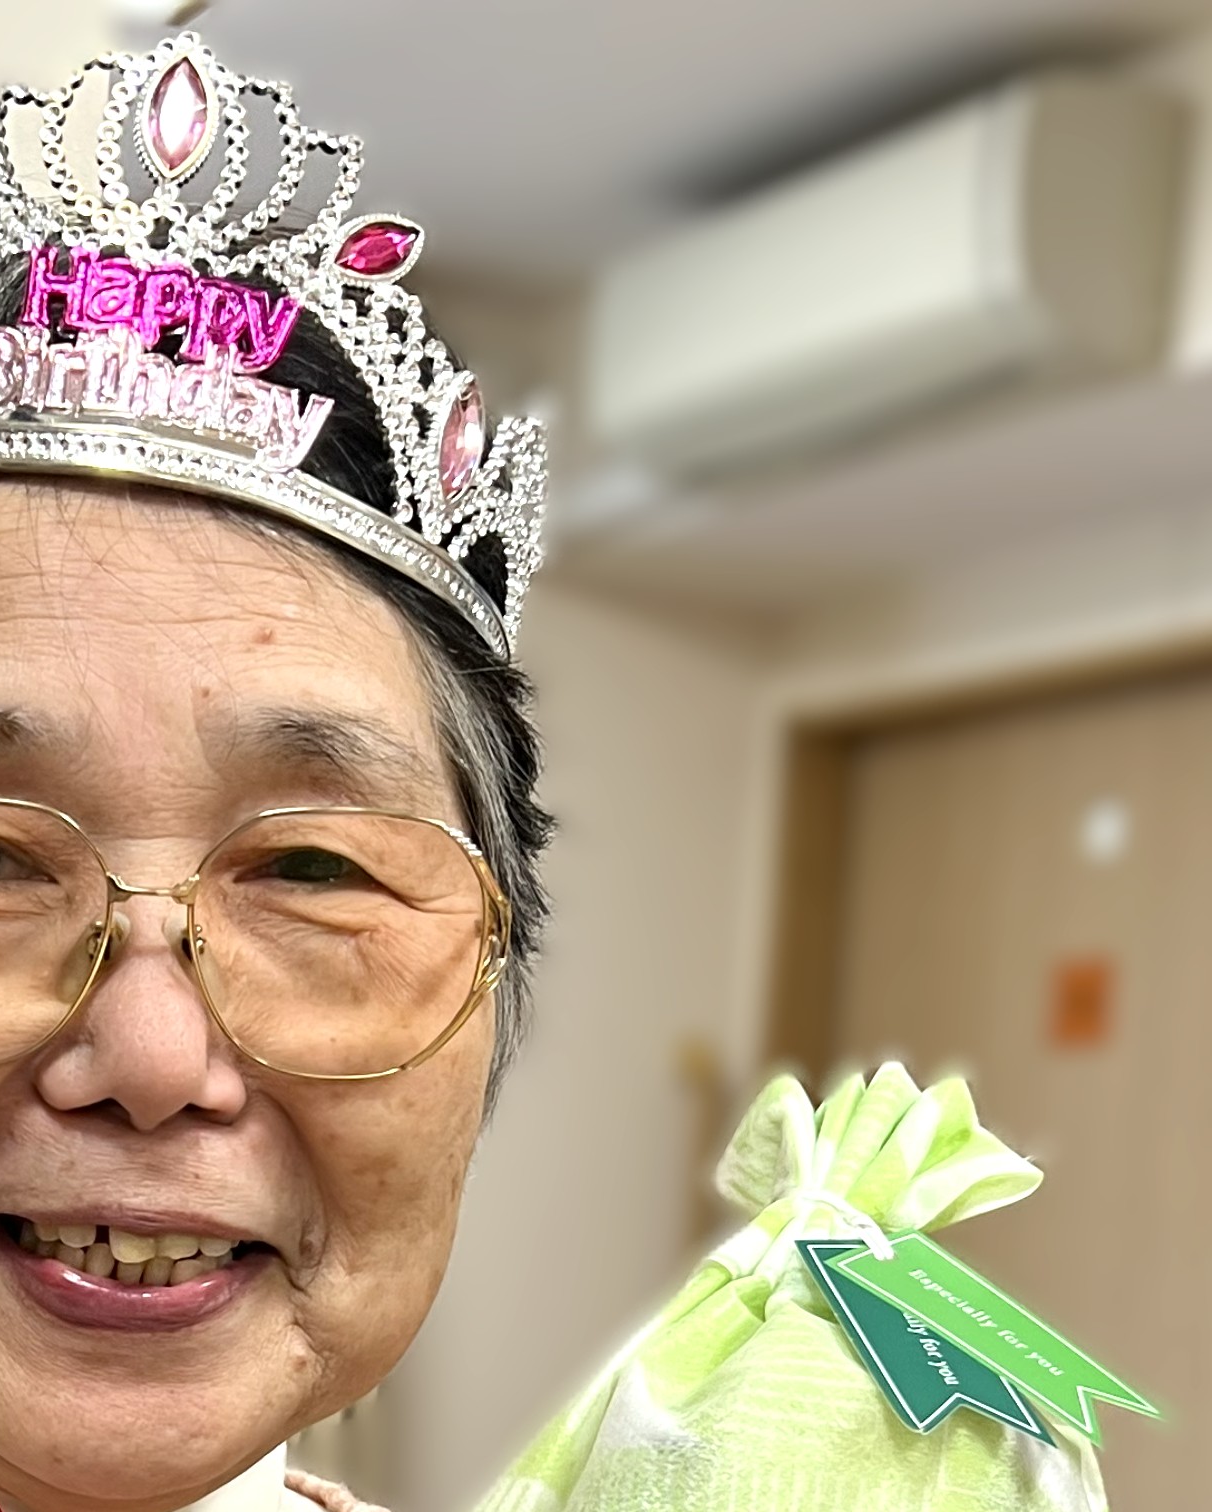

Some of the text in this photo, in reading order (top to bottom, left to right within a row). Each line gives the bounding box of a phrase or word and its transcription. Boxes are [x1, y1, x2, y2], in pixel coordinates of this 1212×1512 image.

[22, 245, 300, 374] Happy
[908, 1269, 998, 1328] Especially
[996, 1329, 1028, 1349] for
[1024, 1352, 1065, 1376] you
[919, 1338, 959, 1386] for you
